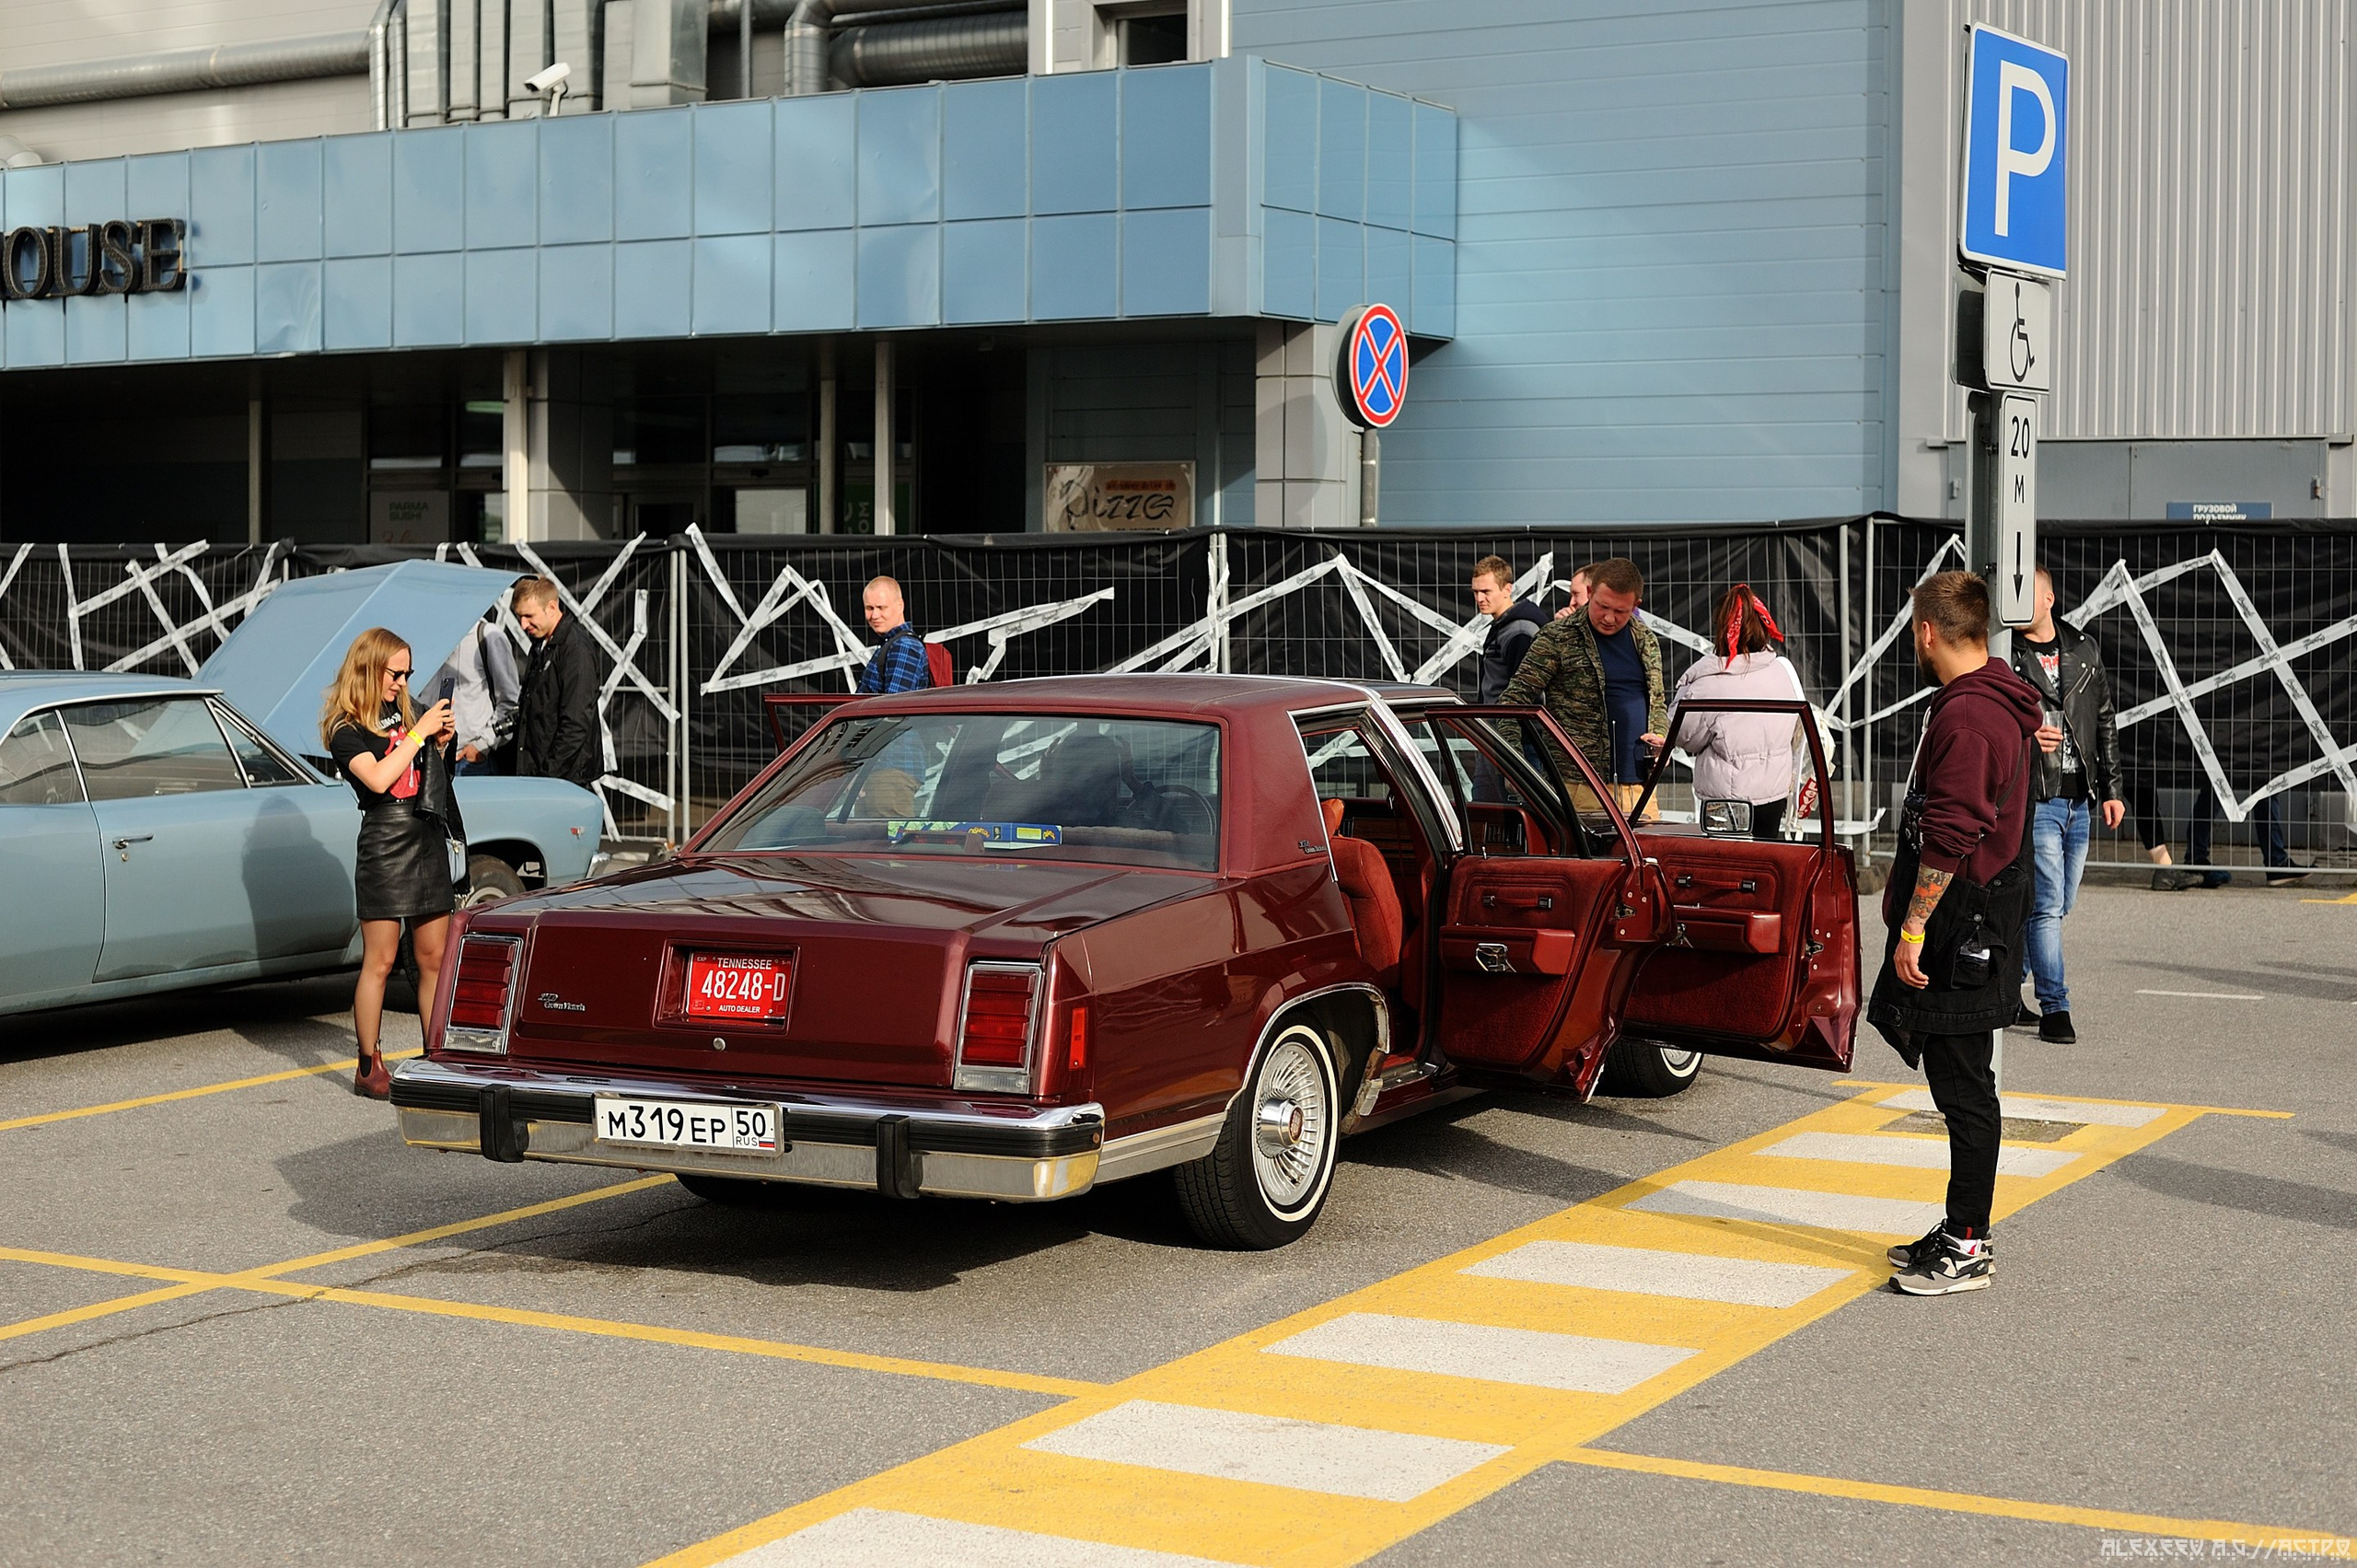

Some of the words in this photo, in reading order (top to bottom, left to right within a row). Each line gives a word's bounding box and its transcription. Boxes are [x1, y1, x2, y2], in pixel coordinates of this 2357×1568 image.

[1994, 60, 2056, 237] P
[0, 217, 187, 299] OUSE
[2011, 414, 2028, 459] 20
[2193, 504, 2237, 513] ГРУЗОВОЙ
[717, 958, 772, 970] TENNESSEE
[701, 970, 786, 1002] 48248-D
[718, 1004, 736, 1013] AUTO
[736, 1005, 761, 1014] DEALER
[736, 1110, 766, 1138] 50
[736, 1136, 758, 1146] RUS
